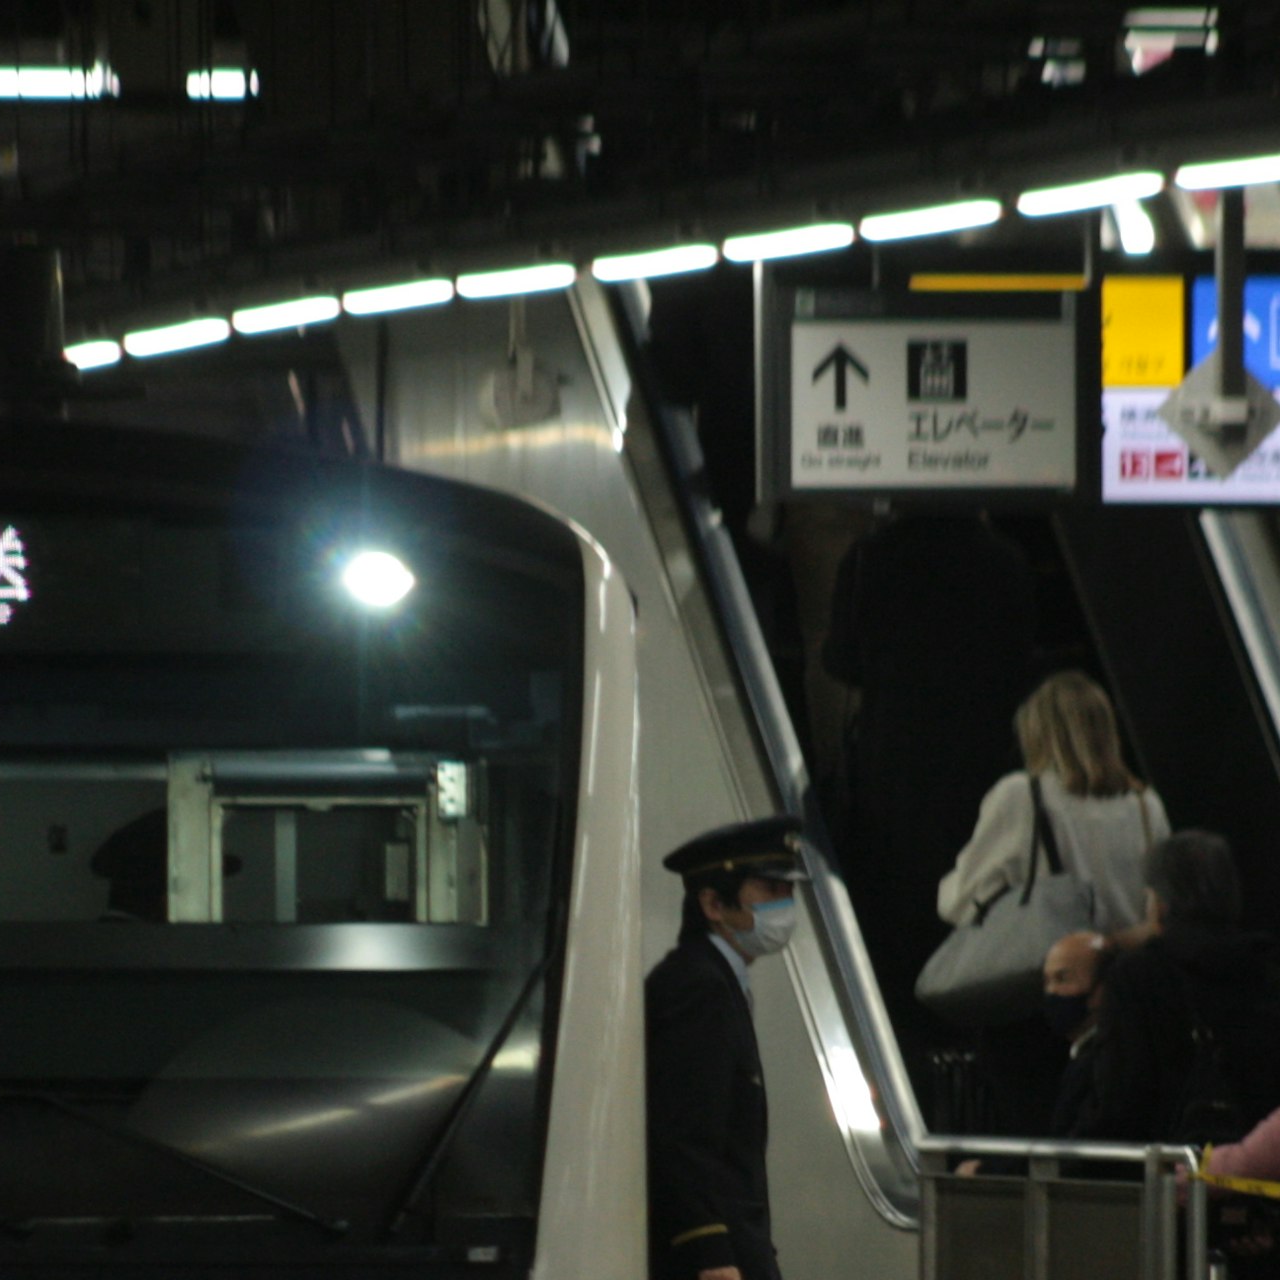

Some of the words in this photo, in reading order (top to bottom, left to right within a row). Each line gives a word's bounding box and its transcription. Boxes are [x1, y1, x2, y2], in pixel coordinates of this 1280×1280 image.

[908, 408, 1055, 443] エレベーター
[908, 449, 990, 472] Elevator
